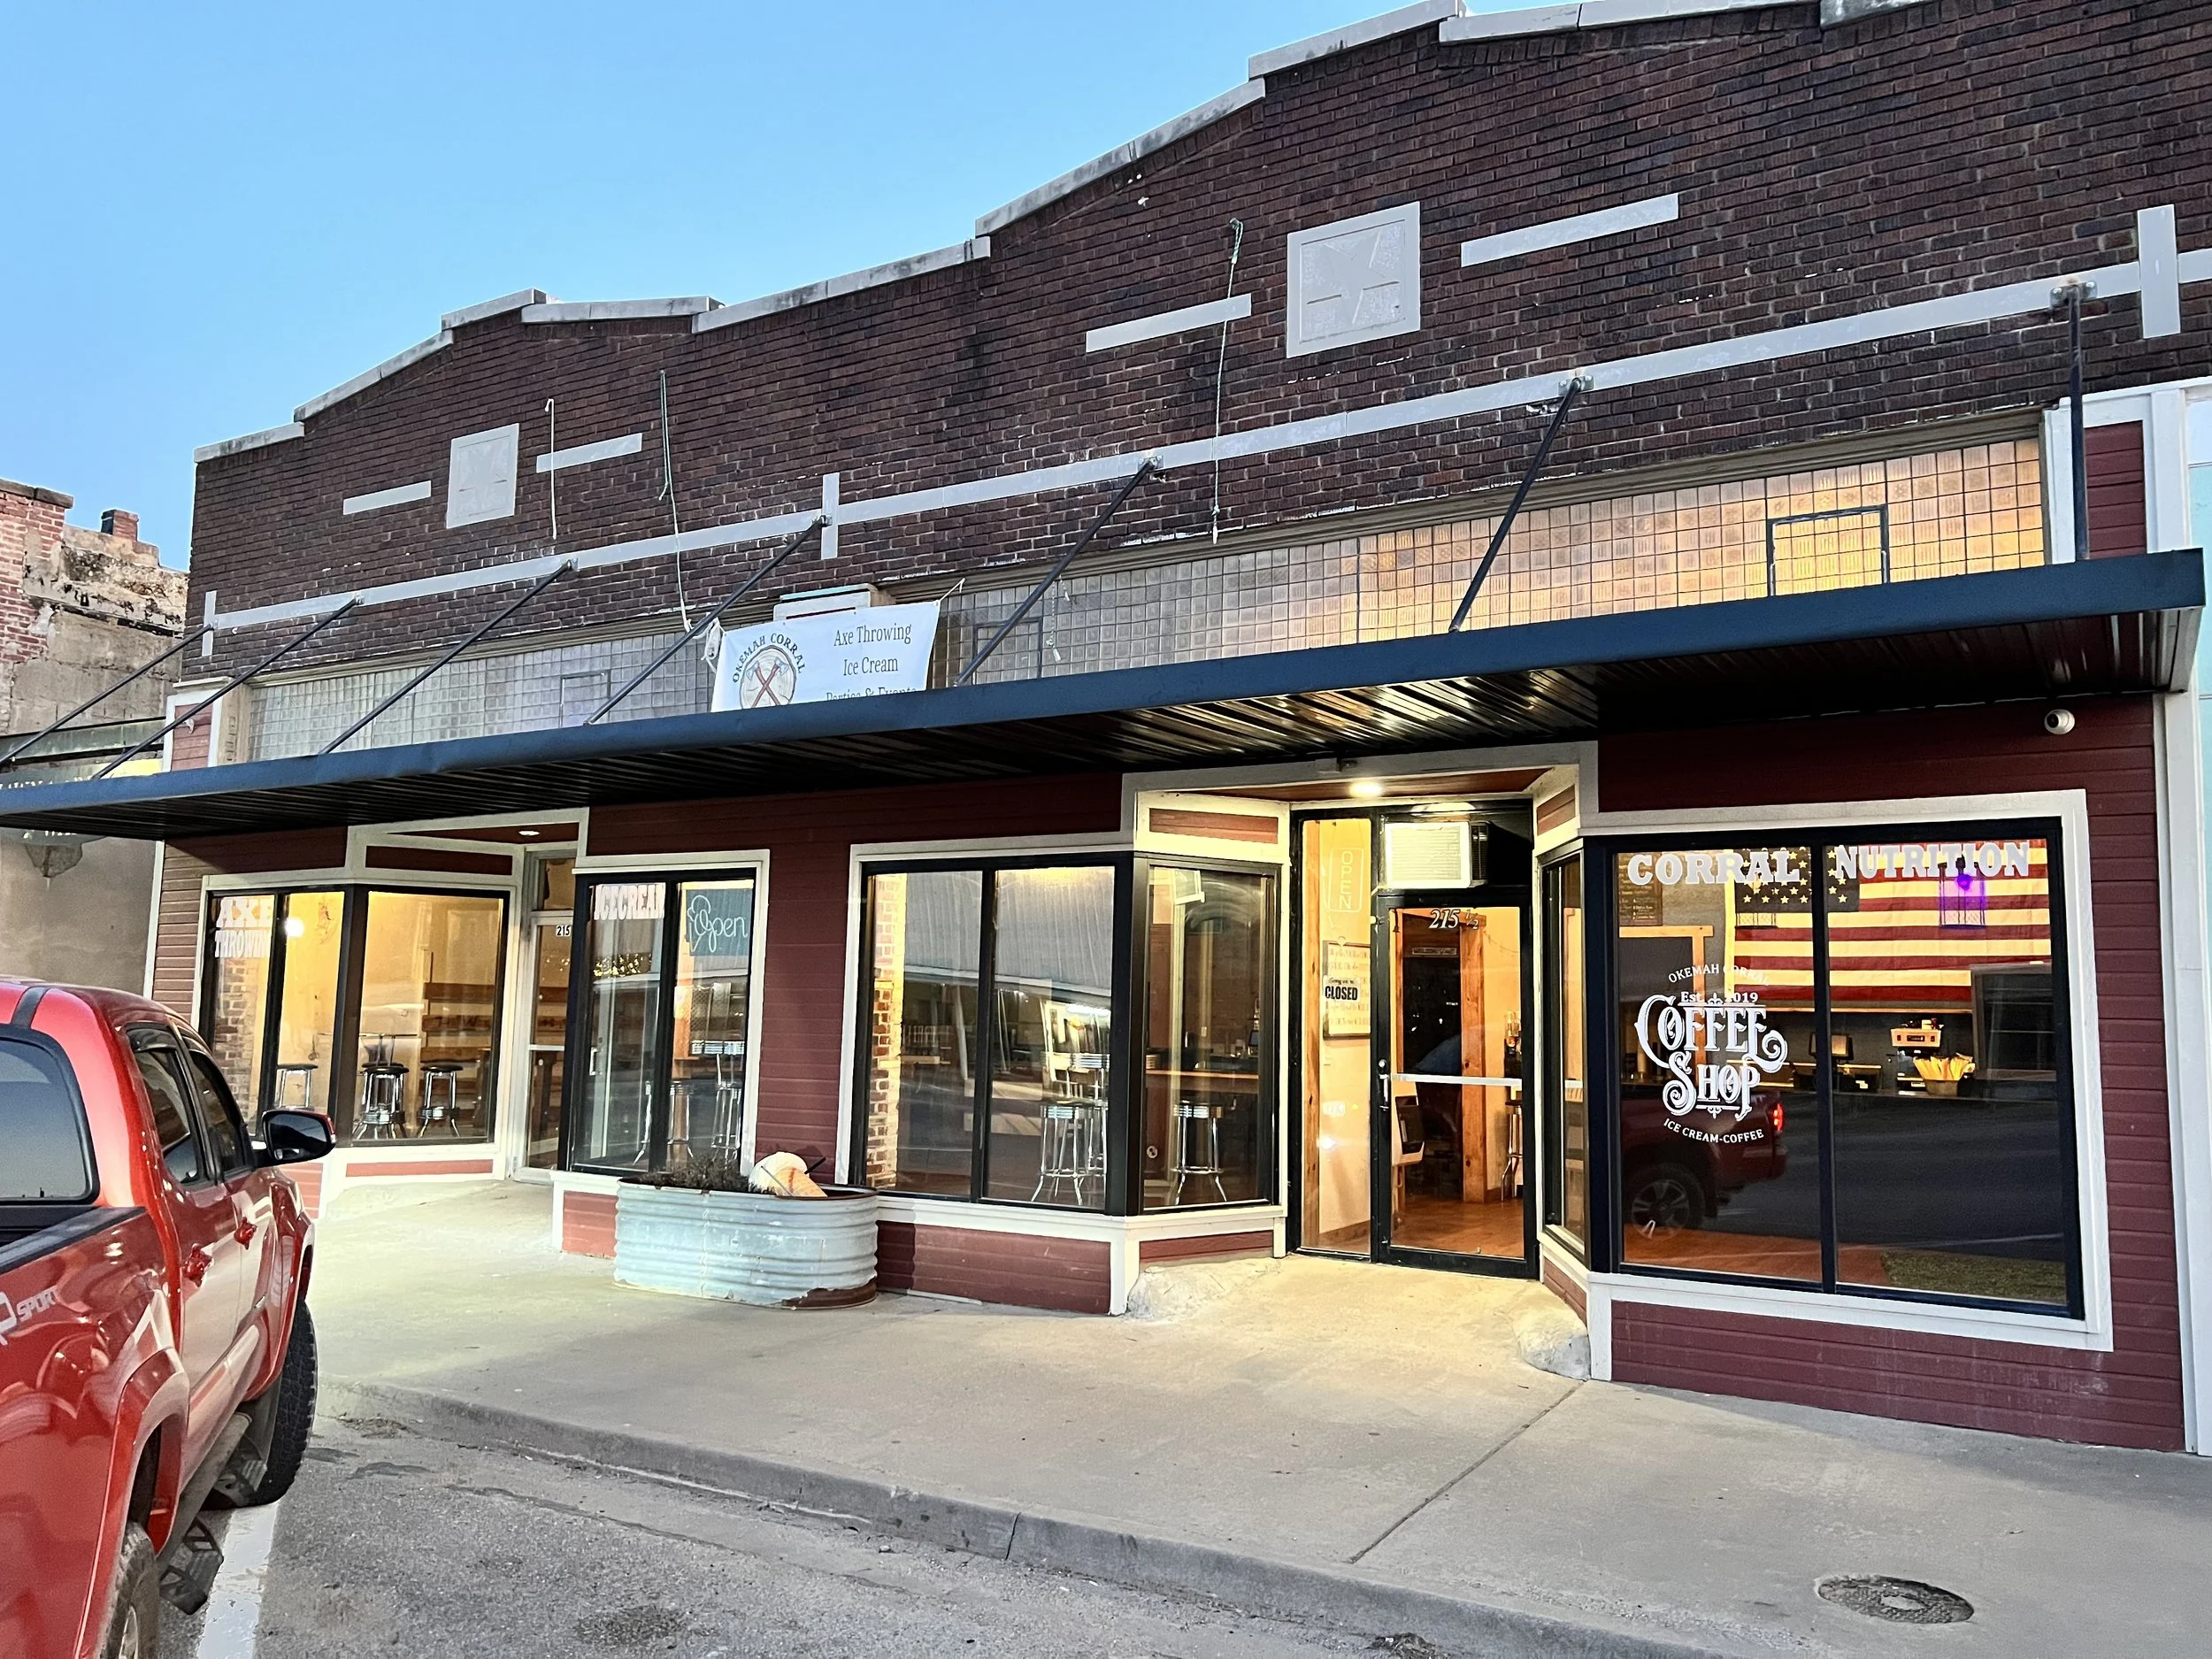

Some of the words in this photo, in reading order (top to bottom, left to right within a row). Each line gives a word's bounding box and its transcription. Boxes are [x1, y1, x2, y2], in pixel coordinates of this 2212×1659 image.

[833, 629, 854, 647] Axe
[856, 623, 912, 645] Throwing
[733, 636, 765, 683] OKEMAH
[771, 633, 807, 673] CORRAL
[843, 658, 858, 677] Ice
[862, 657, 899, 674] Cream
[1627, 850, 1801, 886] CORRAL
[1834, 840, 2031, 879] NUTRITION
[1339, 850, 1354, 910] OPEN
[216, 896, 273, 928] AXE
[1429, 909, 1461, 929] 215
[557, 926, 571, 936] 215
[693, 906, 749, 953] Open
[1668, 964, 1720, 983] OKEMAH
[1325, 986, 1358, 1001] CLOSED
[1634, 995, 1788, 1073] COFFEE
[1663, 1051, 1761, 1122] SHOP
[1663, 1118, 1682, 1133] ICE
[16, 1285, 59, 1323] SPORT
